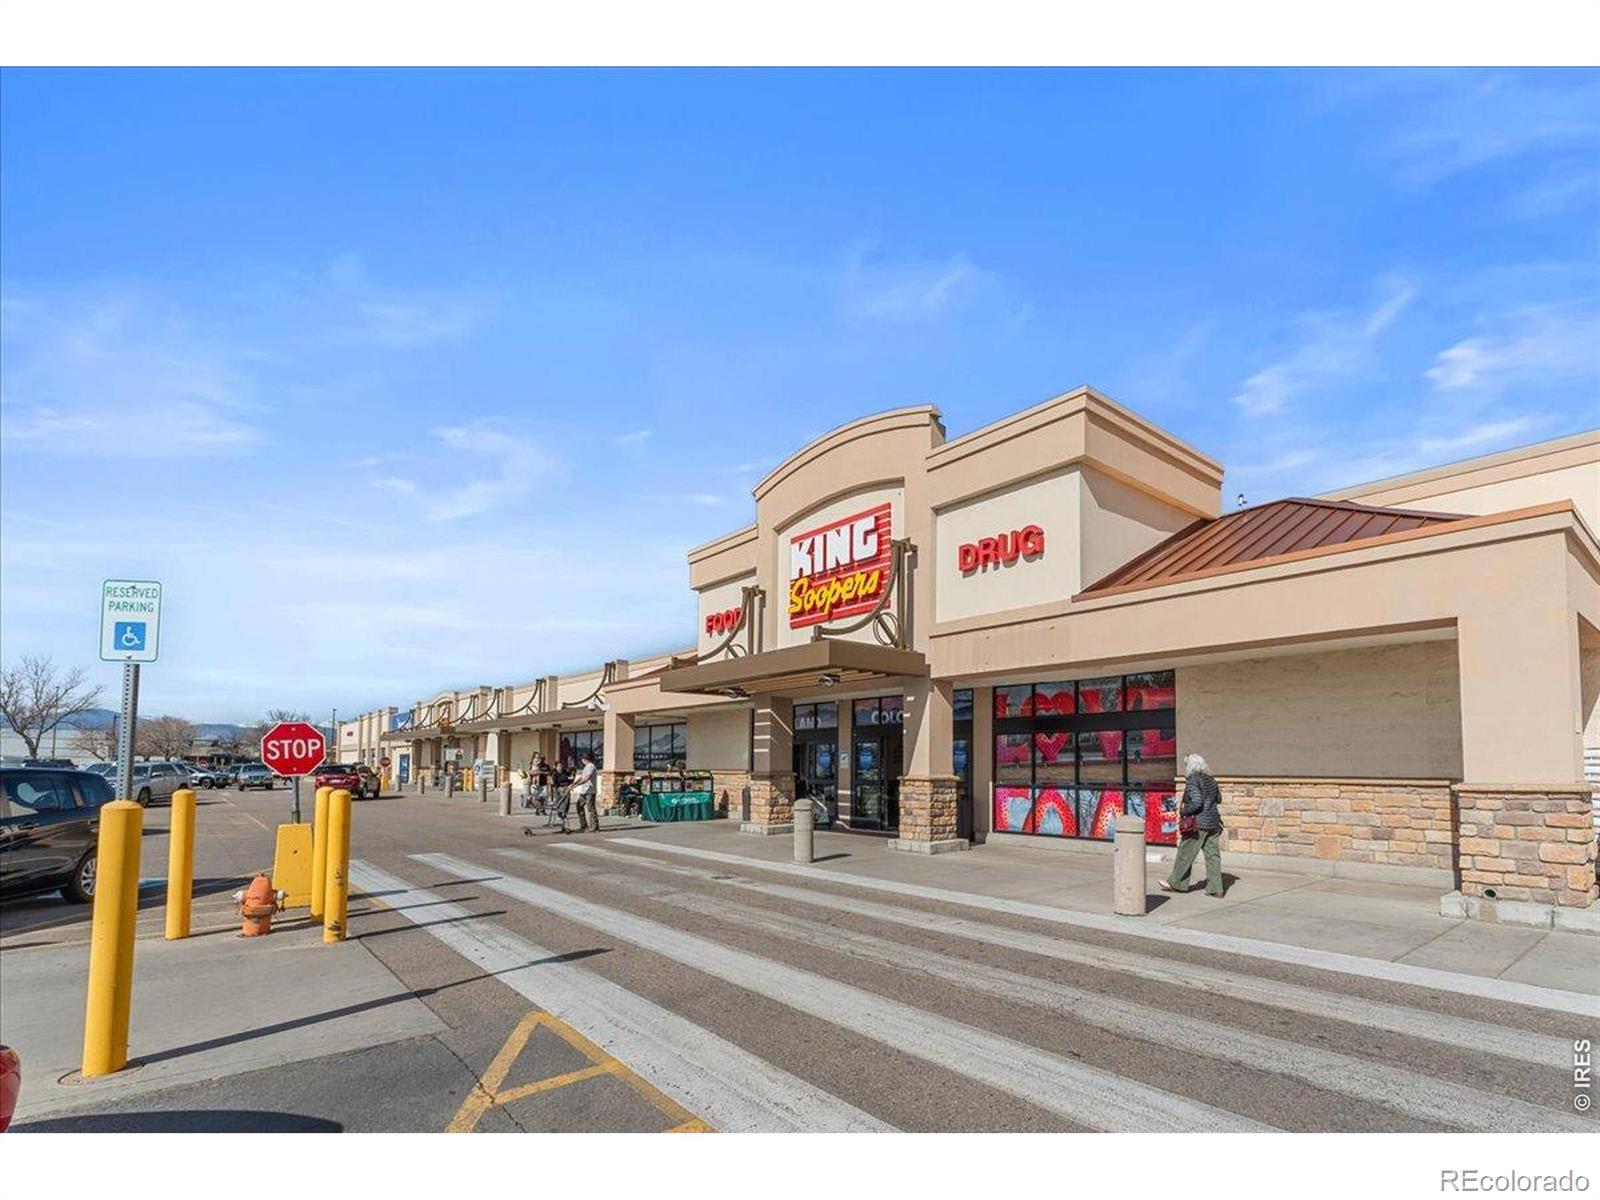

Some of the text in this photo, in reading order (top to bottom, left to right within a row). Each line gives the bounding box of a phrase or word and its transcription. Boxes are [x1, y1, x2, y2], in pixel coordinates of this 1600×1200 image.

[790, 515, 879, 580] KING
[959, 525, 1045, 572] DRUG
[105, 586, 159, 599] RESERVED
[108, 600, 155, 613] PARKING
[787, 569, 880, 615] Soopers
[266, 739, 321, 761] STOP
